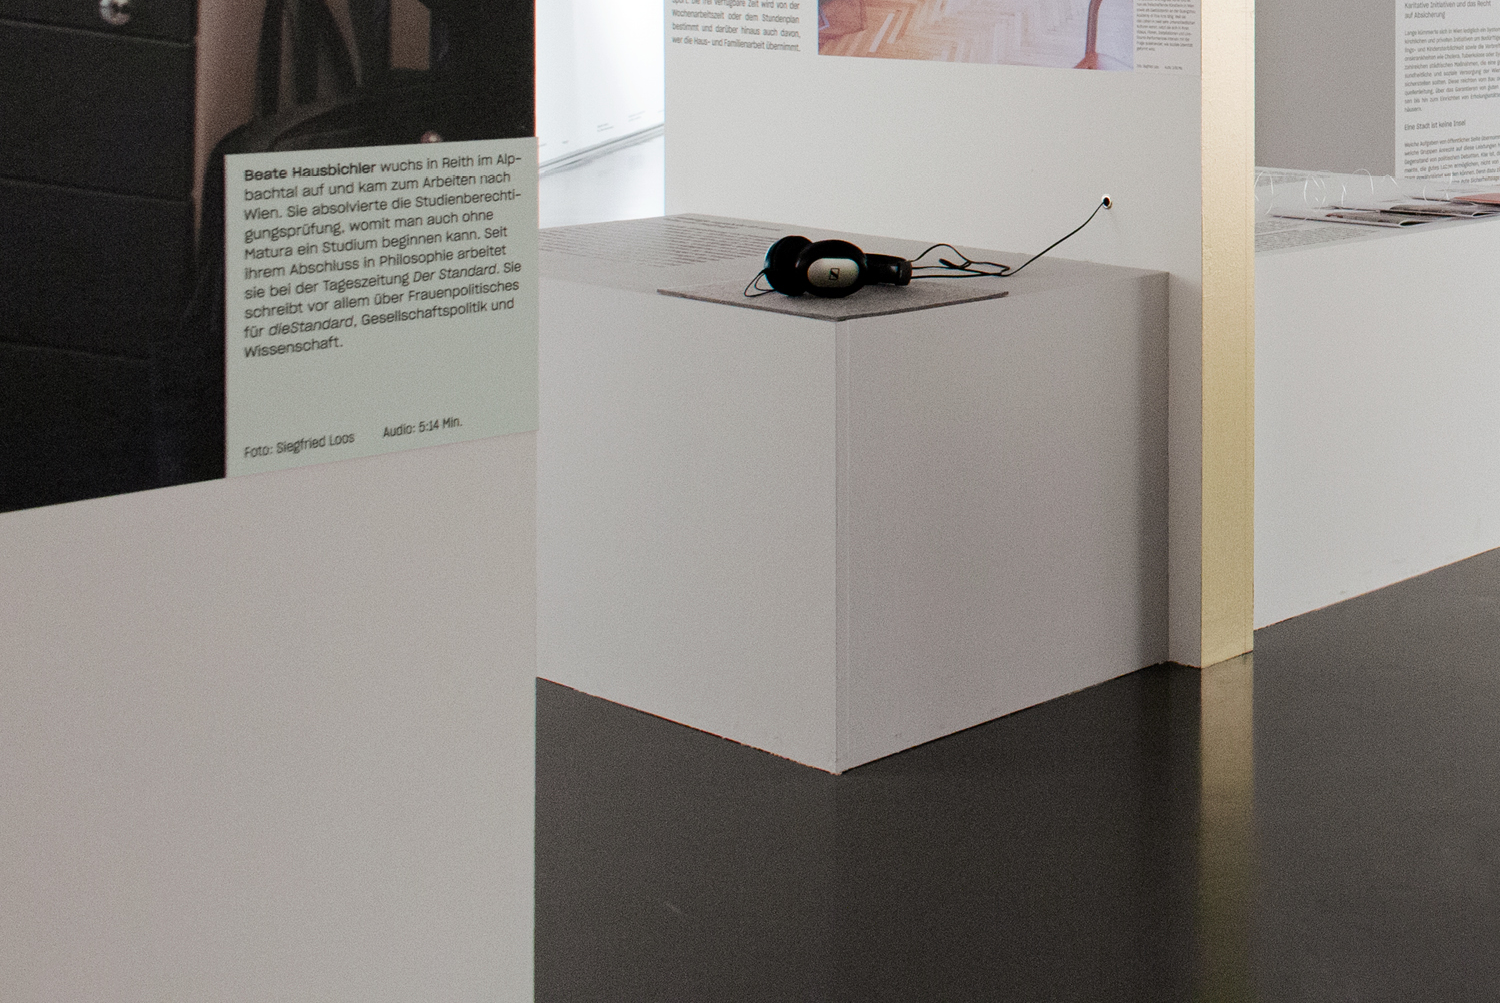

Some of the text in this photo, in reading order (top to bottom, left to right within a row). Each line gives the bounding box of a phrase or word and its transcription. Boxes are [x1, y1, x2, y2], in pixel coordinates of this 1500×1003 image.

[243, 153, 522, 182] Beate Hausbichler wuchs in Reith im Alp-
[244, 171, 511, 201] bachtal auf und kam zum Arbeiten nach
[243, 188, 521, 221] Wien. Sie absolvierte die Studienberechti-
[244, 210, 494, 244] gungsprüfung, womit man auch ohne
[244, 225, 508, 260] Matura ein Studium beginnen kann. Seit
[244, 244, 506, 280] ihrem Abschluss in Philosophie arbeitet
[244, 261, 522, 300] sie bei der Tageszeitung Der Standard. Sie
[244, 280, 520, 320] schreibt vor allem über Frauenpolitisches
[243, 297, 514, 339] für dieStandard, Gesellschaftspolitik und
[243, 335, 343, 358] Wissenschaft.
[382, 416, 463, 438] Audio: 5:14 Min.
[243, 433, 355, 458] Foto: Siegfried Loos
